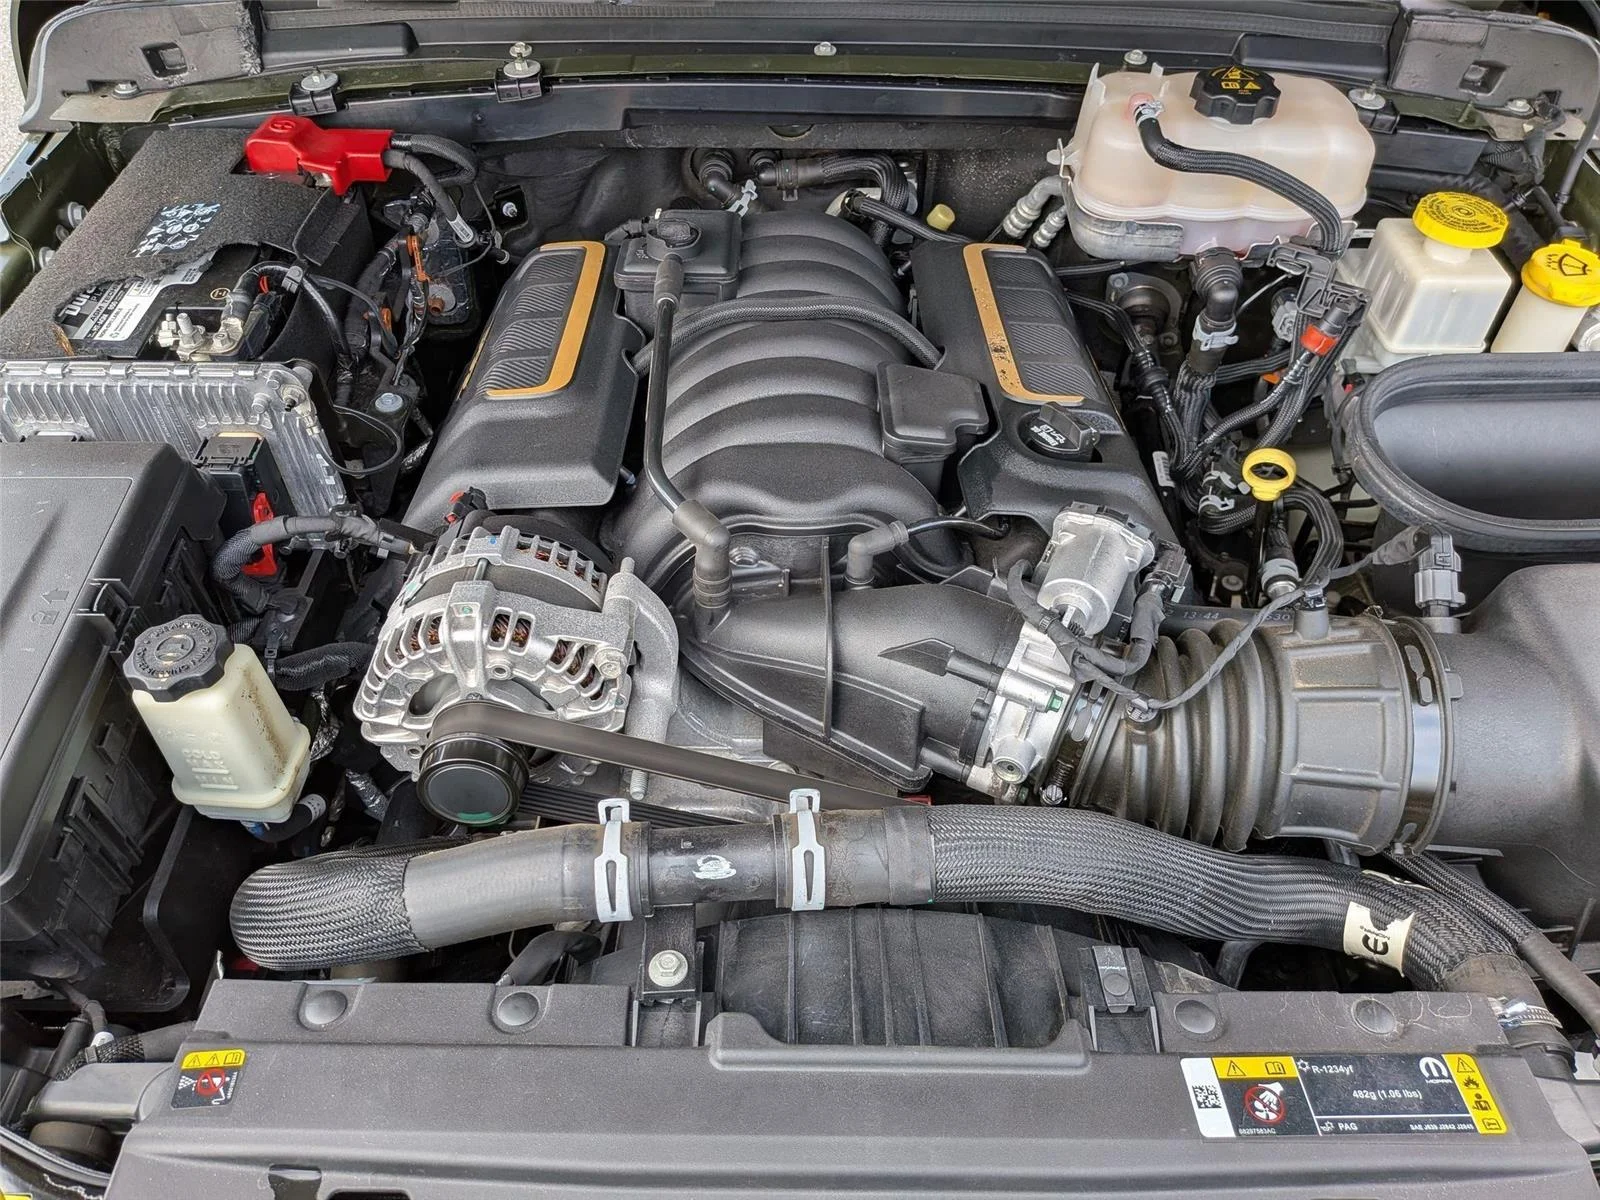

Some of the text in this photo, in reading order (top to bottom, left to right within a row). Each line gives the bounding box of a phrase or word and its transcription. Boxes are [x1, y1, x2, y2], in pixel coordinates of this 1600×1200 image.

[91, 305, 105, 321] AGM
[1312, 1065, 1354, 1076] R-1234yf
[1352, 1089, 1422, 1100] 482g (1.06 lbs)
[1338, 1122, 1358, 1131] PAG
